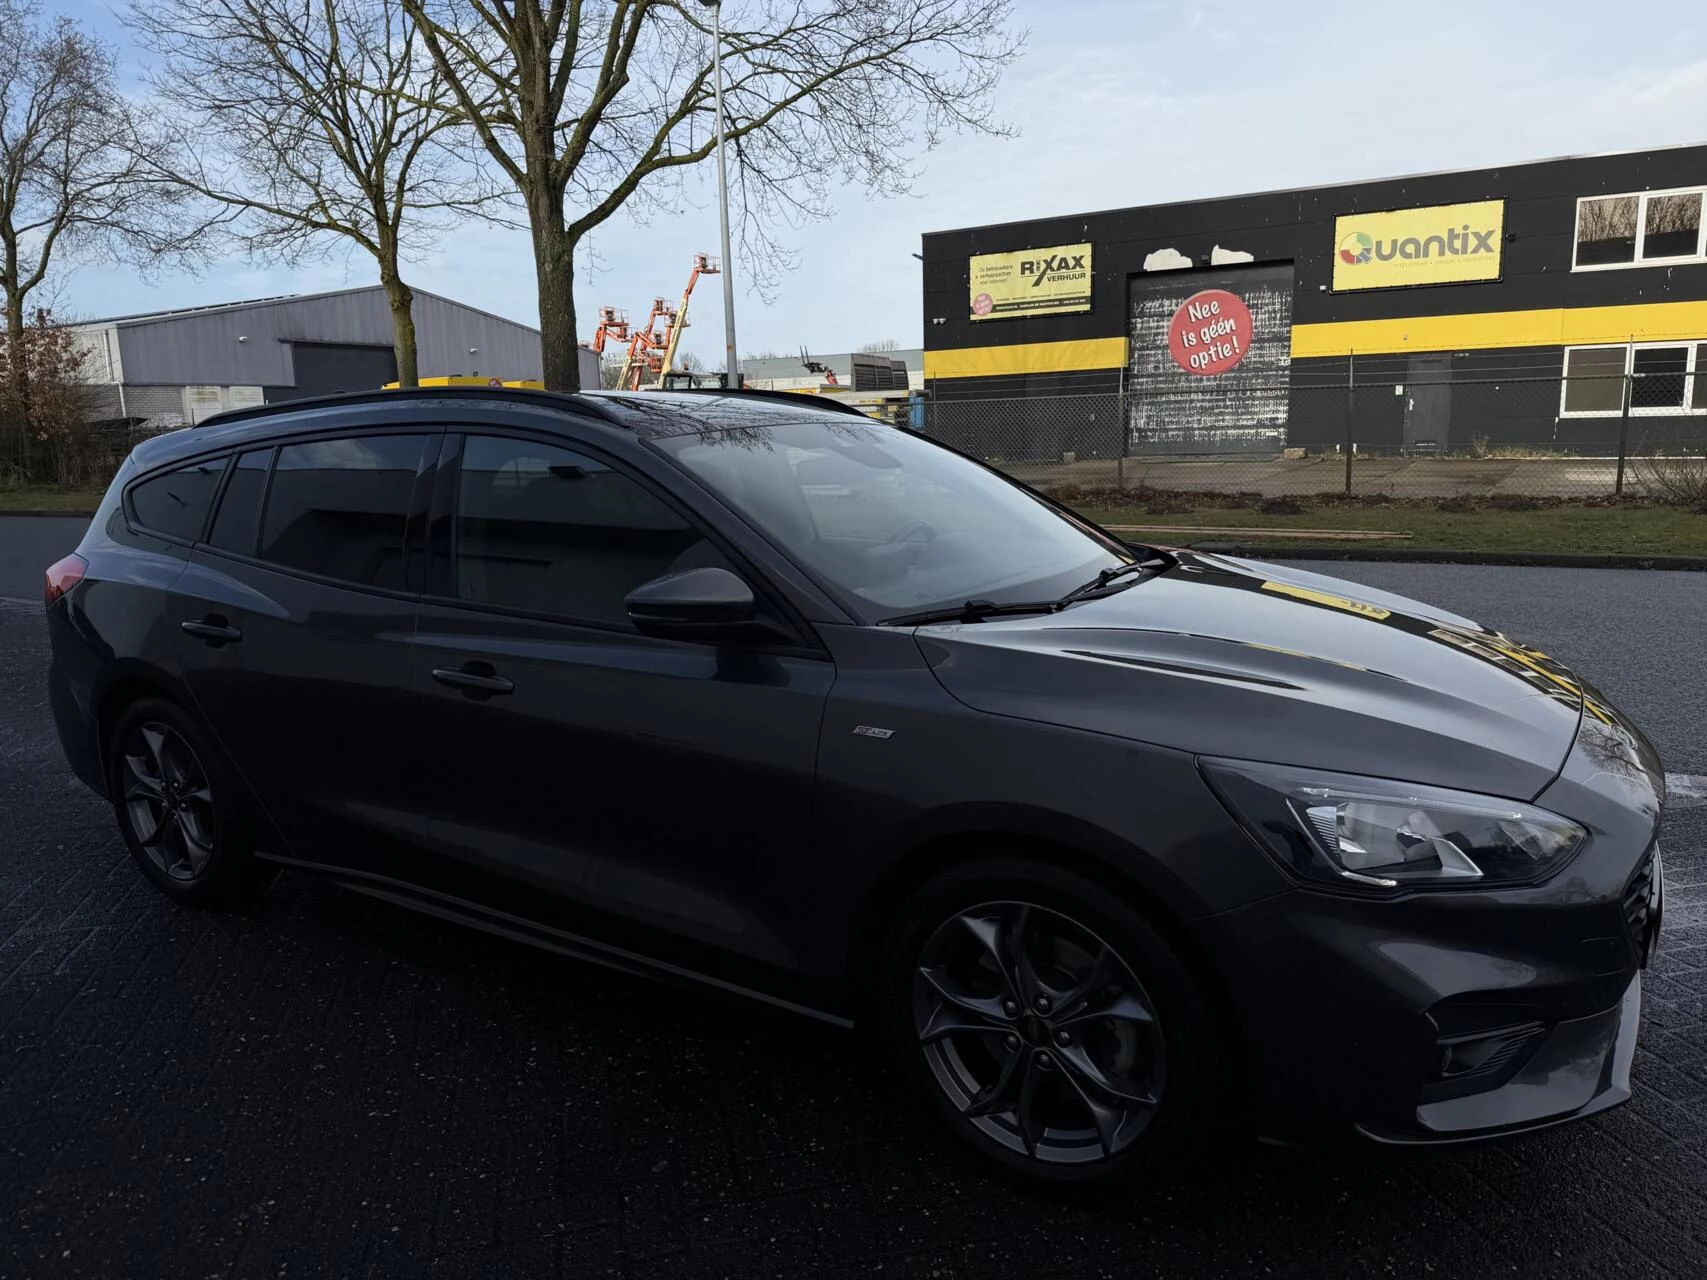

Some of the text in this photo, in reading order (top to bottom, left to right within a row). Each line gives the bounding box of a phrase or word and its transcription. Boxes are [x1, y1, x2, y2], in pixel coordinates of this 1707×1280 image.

[1047, 272, 1086, 283] VERHUUR
[1188, 300, 1220, 323] Nee
[1181, 317, 1236, 348] is géén
